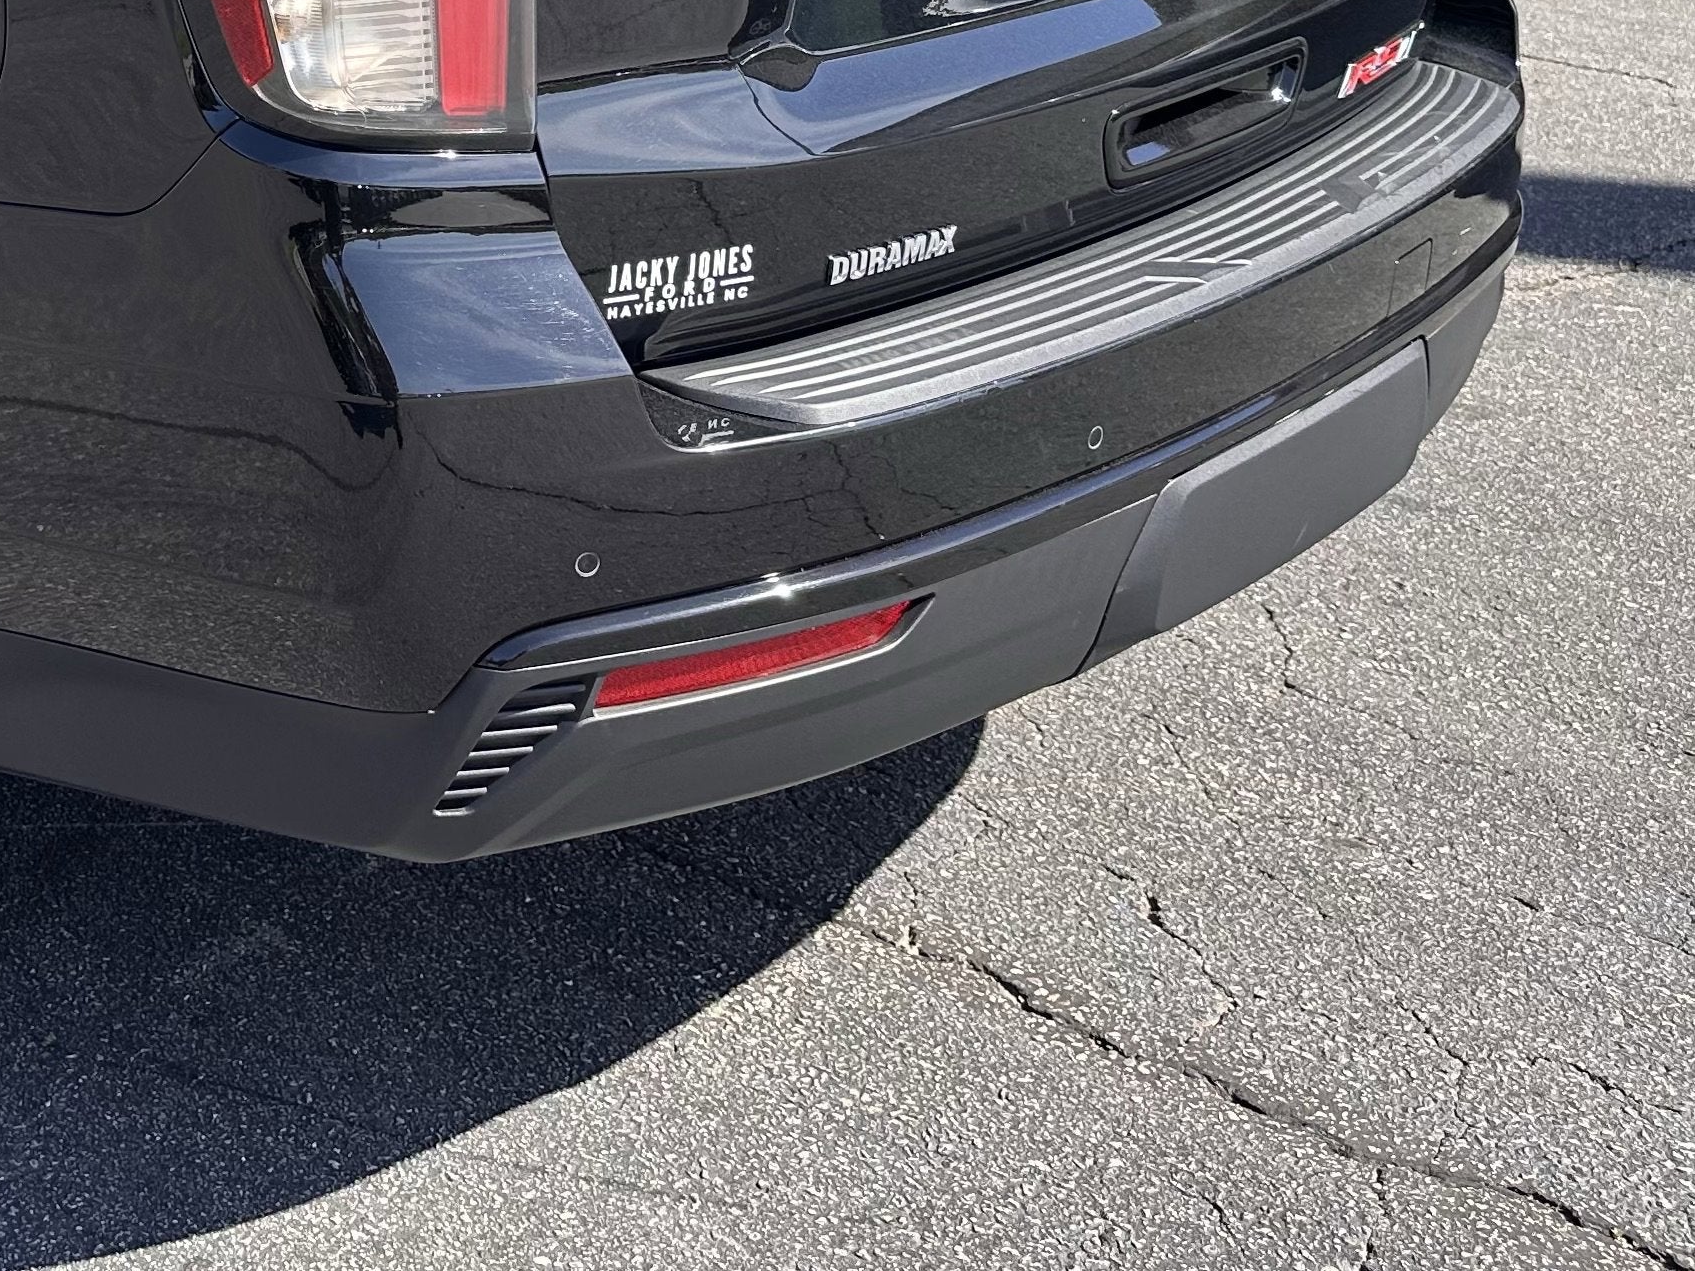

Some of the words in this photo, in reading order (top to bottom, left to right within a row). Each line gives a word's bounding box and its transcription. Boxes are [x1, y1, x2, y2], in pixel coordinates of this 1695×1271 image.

[607, 255, 680, 294] JACKY
[686, 243, 754, 282] JONES
[826, 223, 958, 286] DURAMAX
[606, 290, 716, 321] HAYESVILLE
[723, 285, 750, 302] NC
[643, 277, 717, 303] FORD
